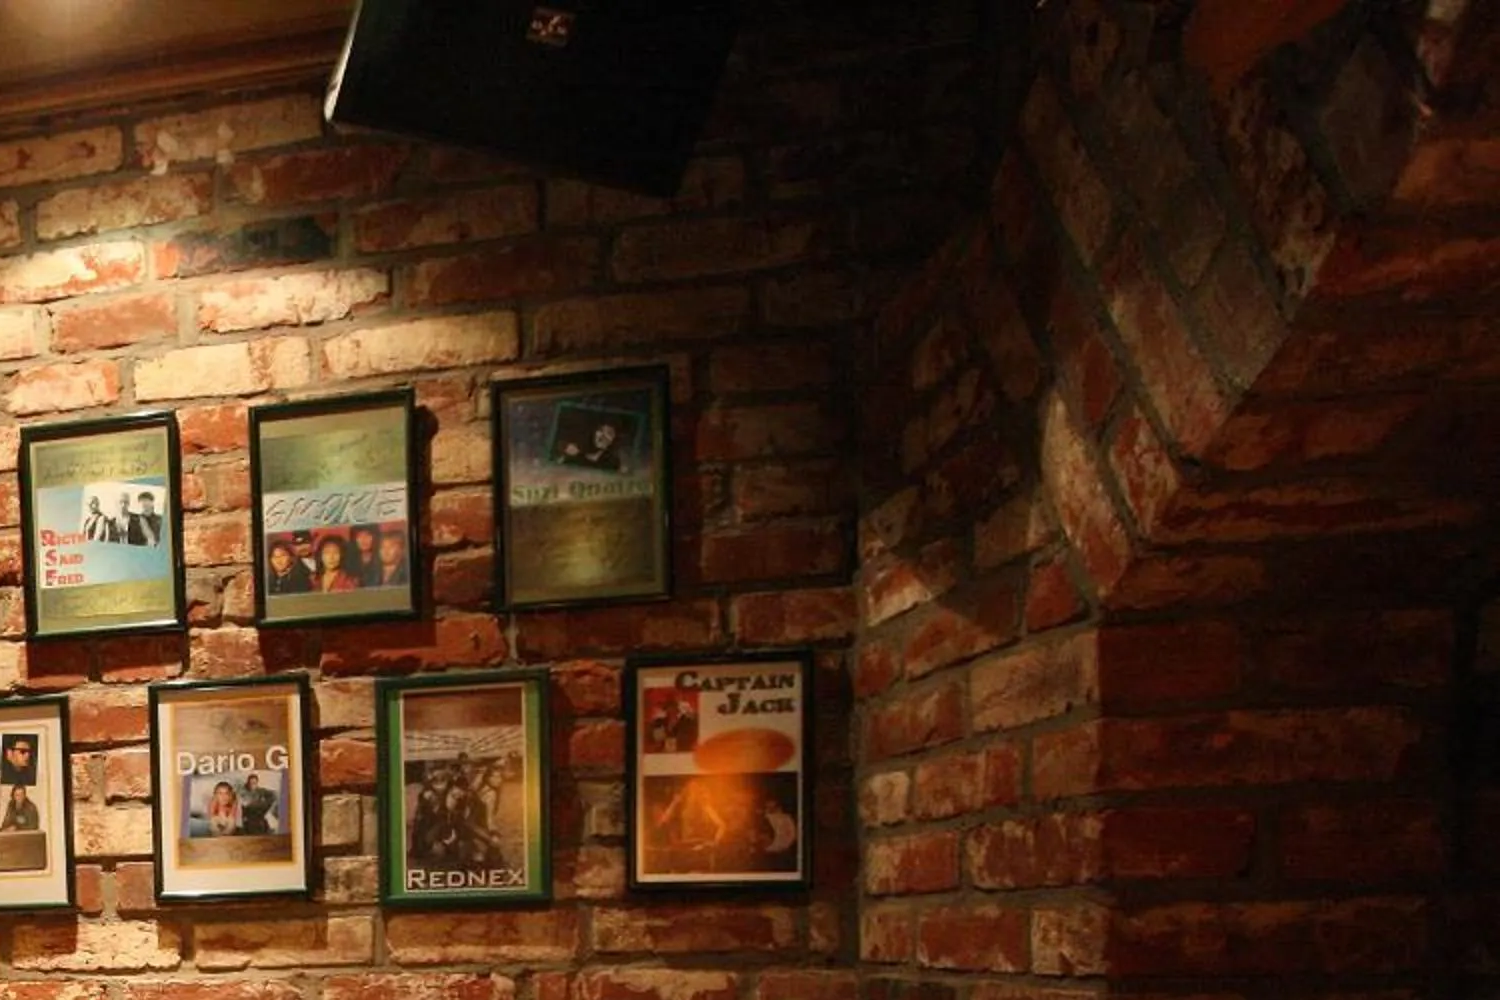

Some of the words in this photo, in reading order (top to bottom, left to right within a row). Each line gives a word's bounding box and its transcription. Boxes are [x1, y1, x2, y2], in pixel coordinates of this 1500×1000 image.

[176, 747, 255, 776] Dario
[266, 746, 289, 769] G
[406, 867, 526, 889] REDNEX
